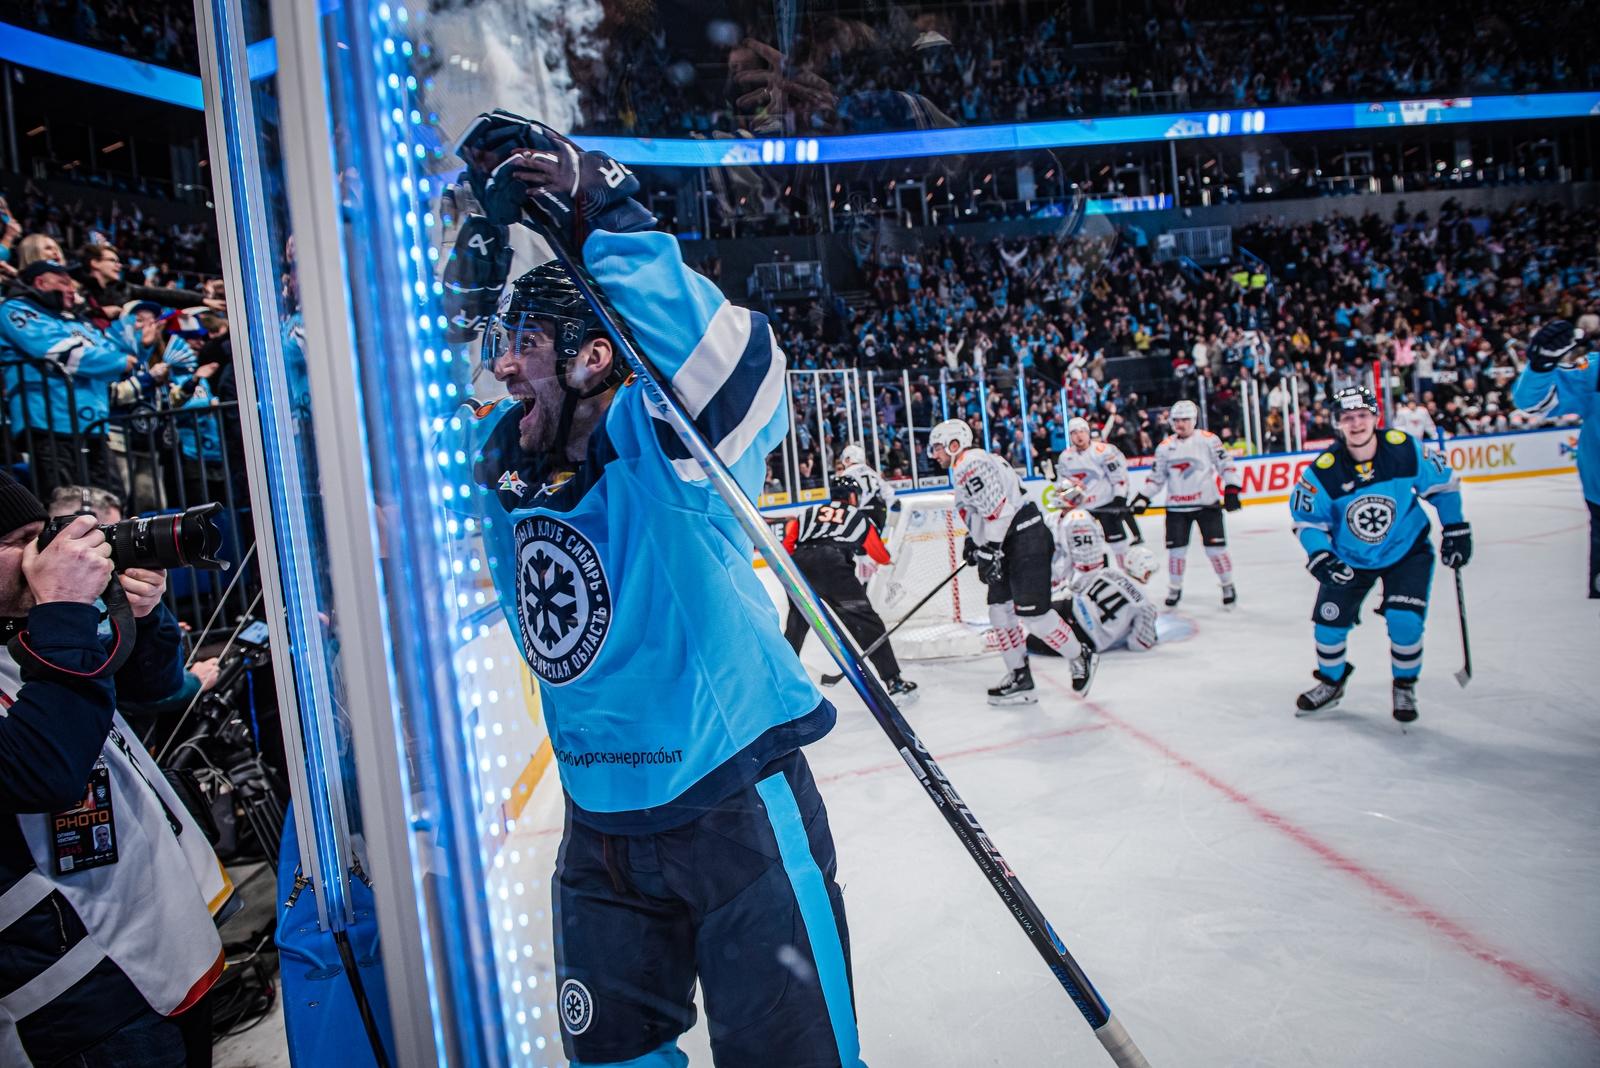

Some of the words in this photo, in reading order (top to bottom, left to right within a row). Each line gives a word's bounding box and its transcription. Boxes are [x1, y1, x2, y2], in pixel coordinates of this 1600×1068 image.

[1450, 443, 1517, 471] ОИСК
[965, 476, 984, 496] 13
[1294, 490, 1313, 513] 15
[818, 506, 845, 524] 31
[1073, 535, 1093, 547] 54
[538, 520, 564, 541] КЛУБ
[565, 535, 602, 591] СИБИРЬ
[571, 606, 607, 668] ОБЛАСТЬ
[56, 810, 110, 831] PHOTO
[991, 875, 1013, 903] TAPER
[1011, 903, 1036, 936] TWITCH
